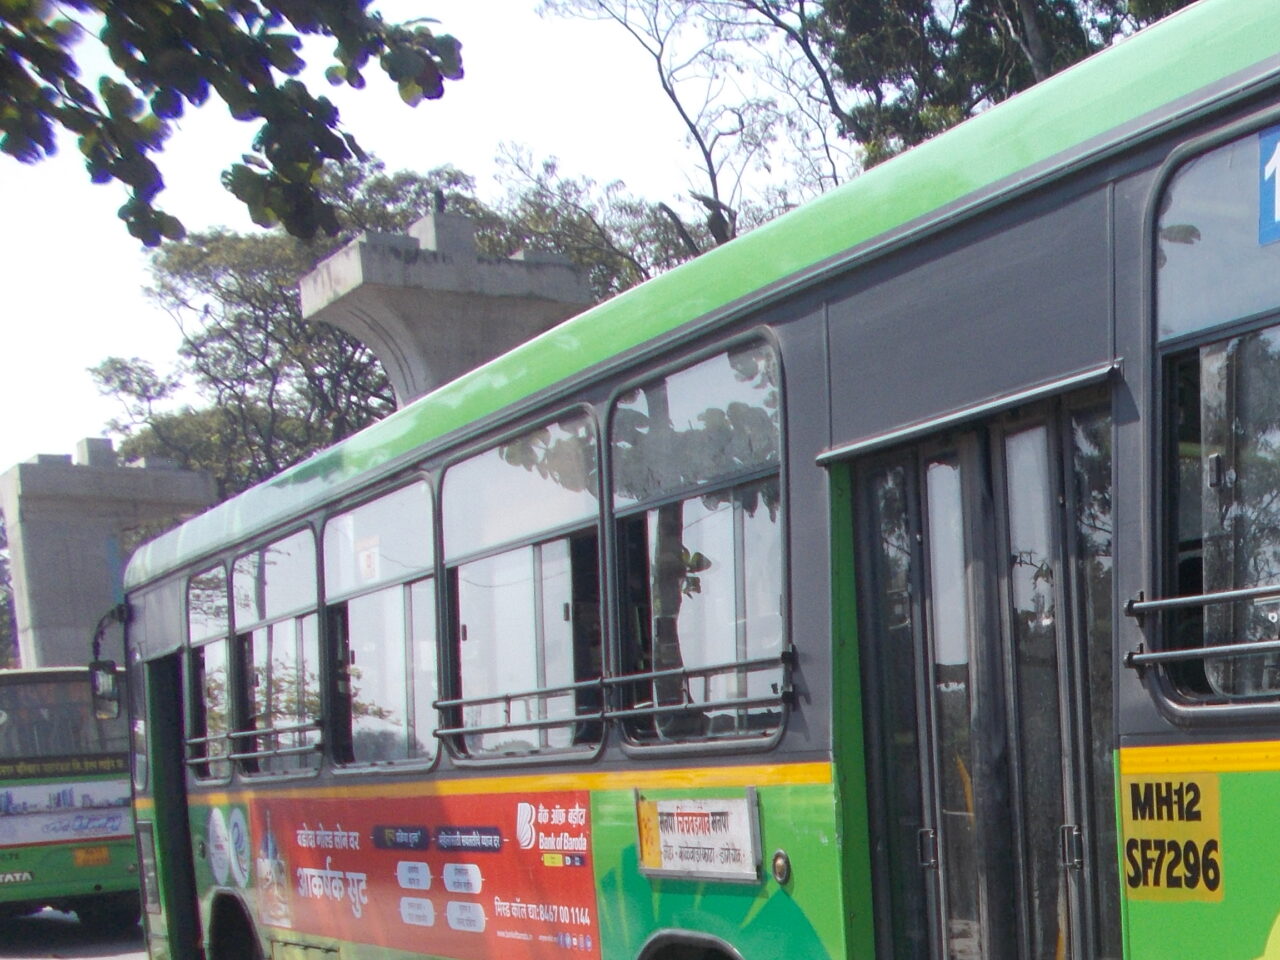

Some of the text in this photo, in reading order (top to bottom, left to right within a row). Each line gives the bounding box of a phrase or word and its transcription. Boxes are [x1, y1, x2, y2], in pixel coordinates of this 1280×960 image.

[539, 831, 556, 850] Bank
[563, 832, 587, 851] Baroda
[296, 855, 344, 901] आकर्षक
